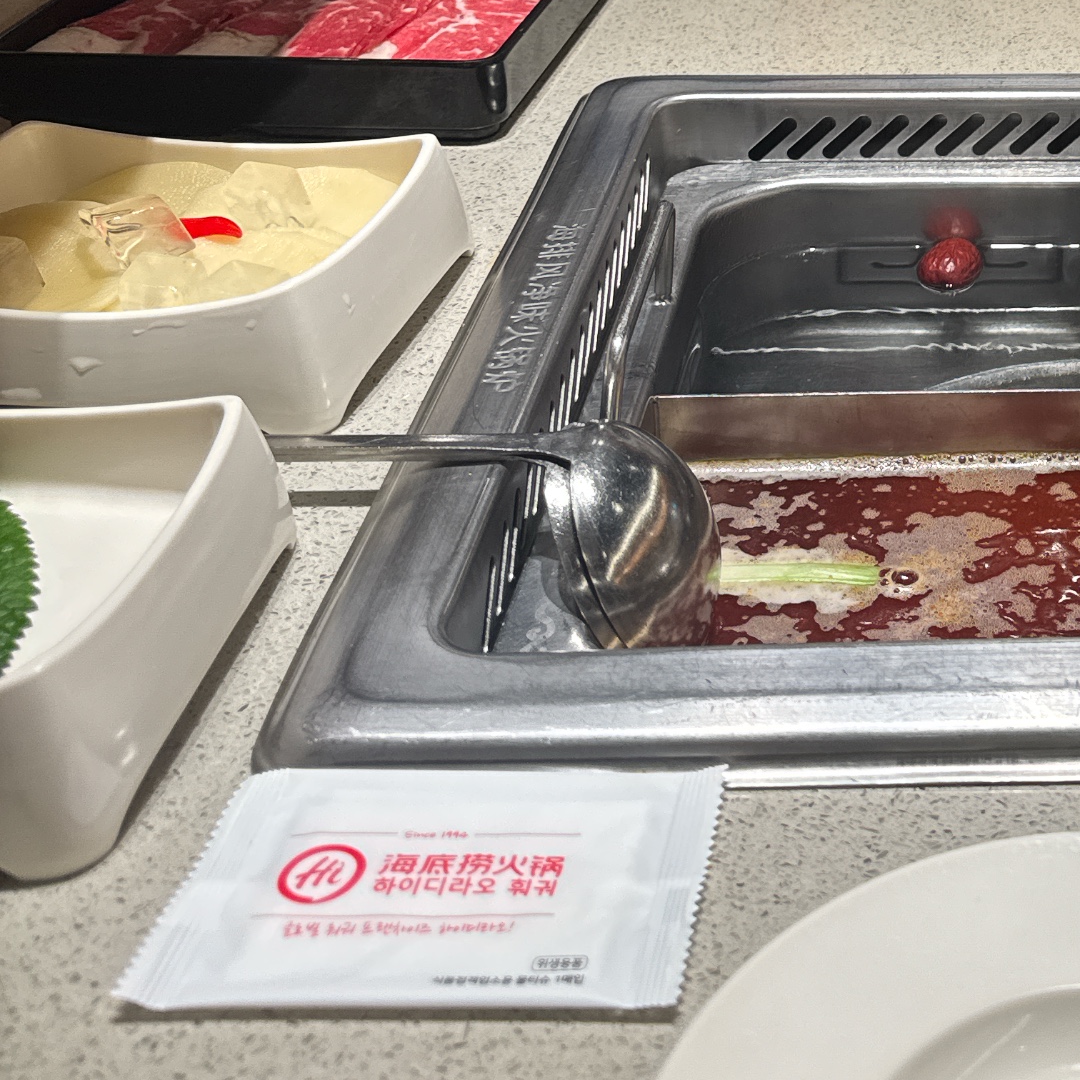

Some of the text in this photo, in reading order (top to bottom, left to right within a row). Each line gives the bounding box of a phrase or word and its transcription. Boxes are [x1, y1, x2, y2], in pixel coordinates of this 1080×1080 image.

[404, 829, 469, 839] Since 1994
[295, 855, 345, 889] Hi
[378, 853, 566, 877] 海底捞火锅
[373, 876, 558, 897] 하이디라오 훠궈
[537, 957, 583, 969] 위생용품
